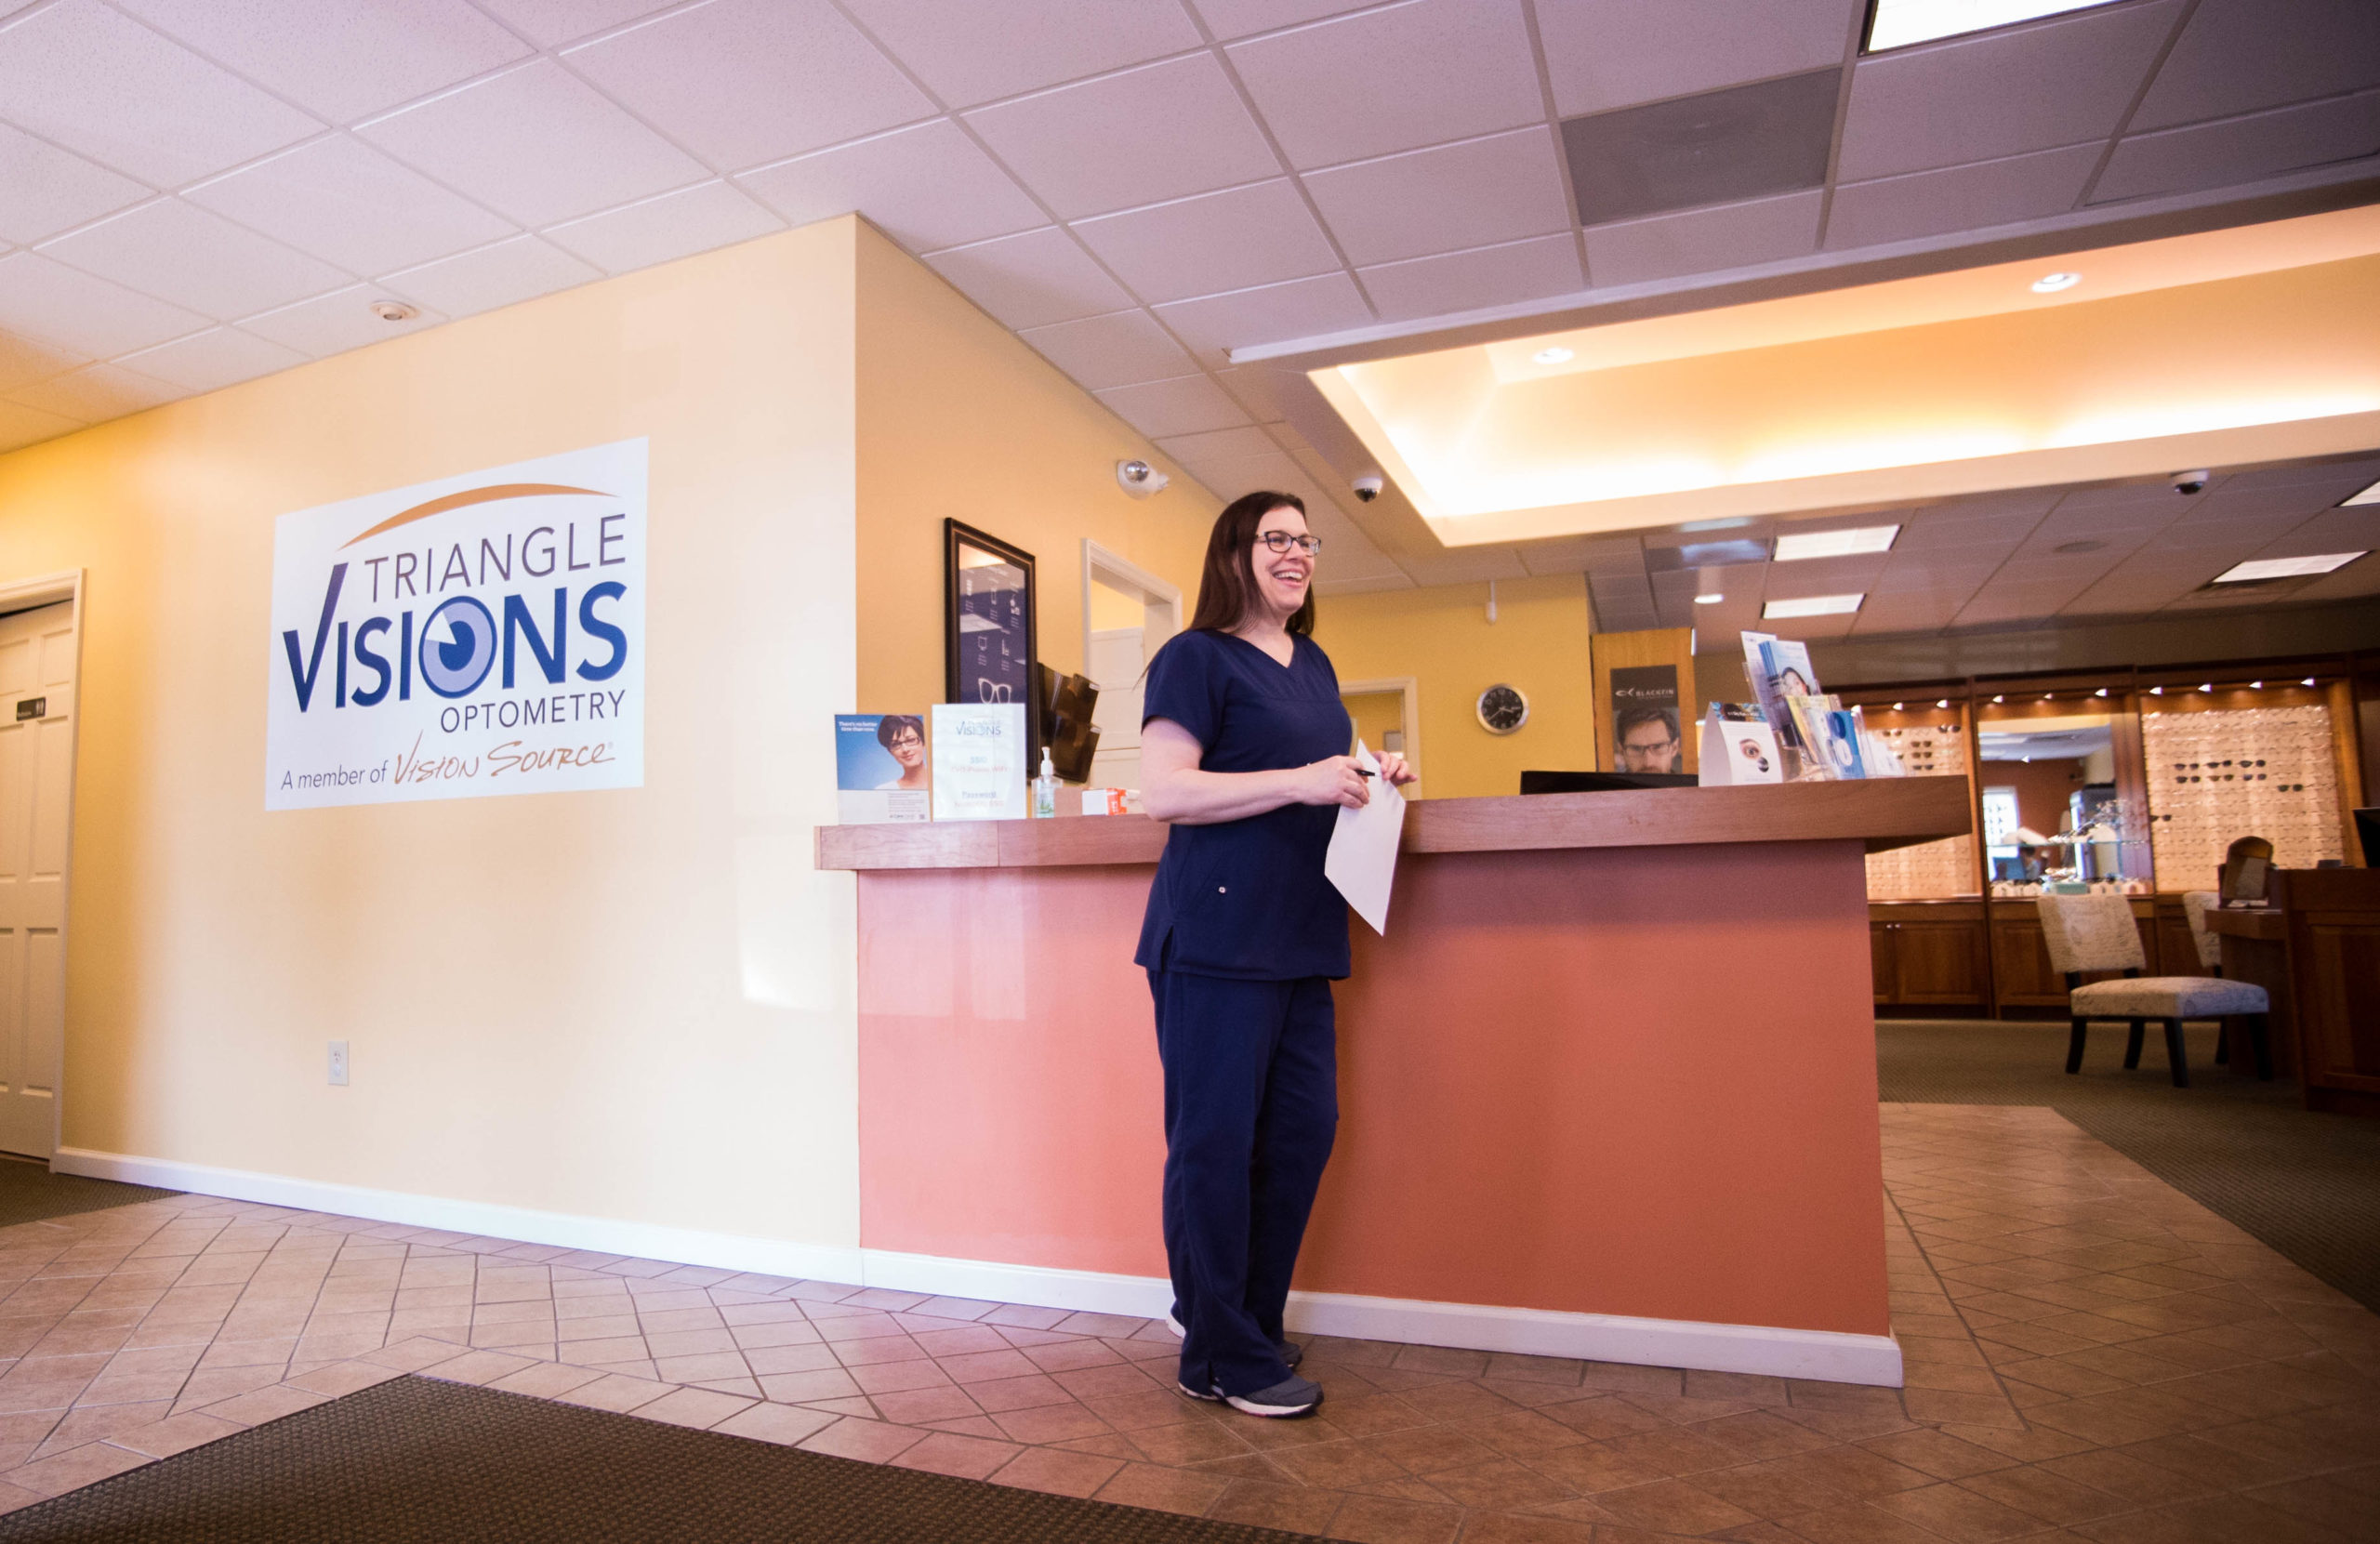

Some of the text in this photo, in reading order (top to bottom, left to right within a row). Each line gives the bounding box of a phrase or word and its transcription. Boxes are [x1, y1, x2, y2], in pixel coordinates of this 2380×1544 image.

[364, 513, 627, 603] TRIANGLE
[282, 562, 628, 713] VISIONS
[441, 690, 626, 733] OPTOMETRY
[281, 771, 294, 790] A
[298, 764, 365, 788] member
[370, 759, 389, 784] of
